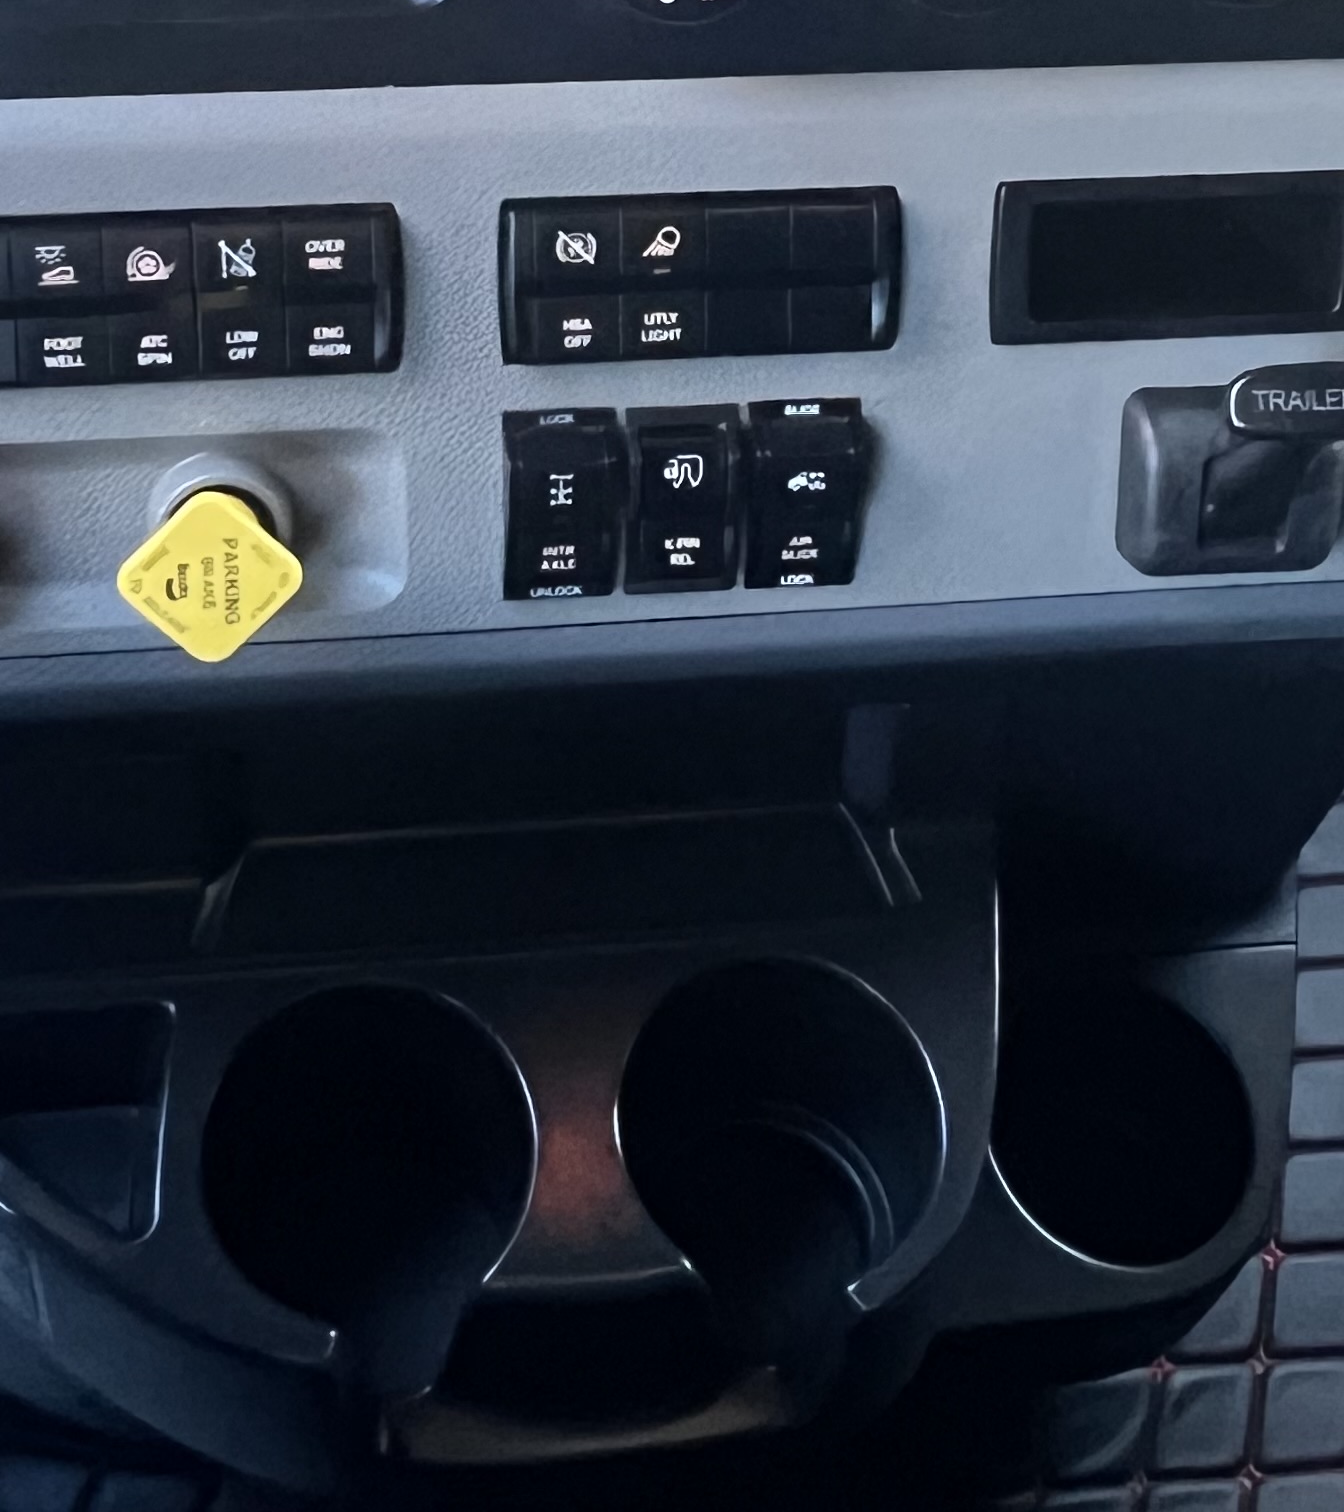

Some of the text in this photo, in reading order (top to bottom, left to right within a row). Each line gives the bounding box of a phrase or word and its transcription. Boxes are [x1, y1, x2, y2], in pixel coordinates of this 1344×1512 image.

[304, 238, 346, 254] OVER
[643, 312, 679, 327] UTLY
[640, 327, 682, 343] LIGHT
[222, 538, 241, 625] PARKING
